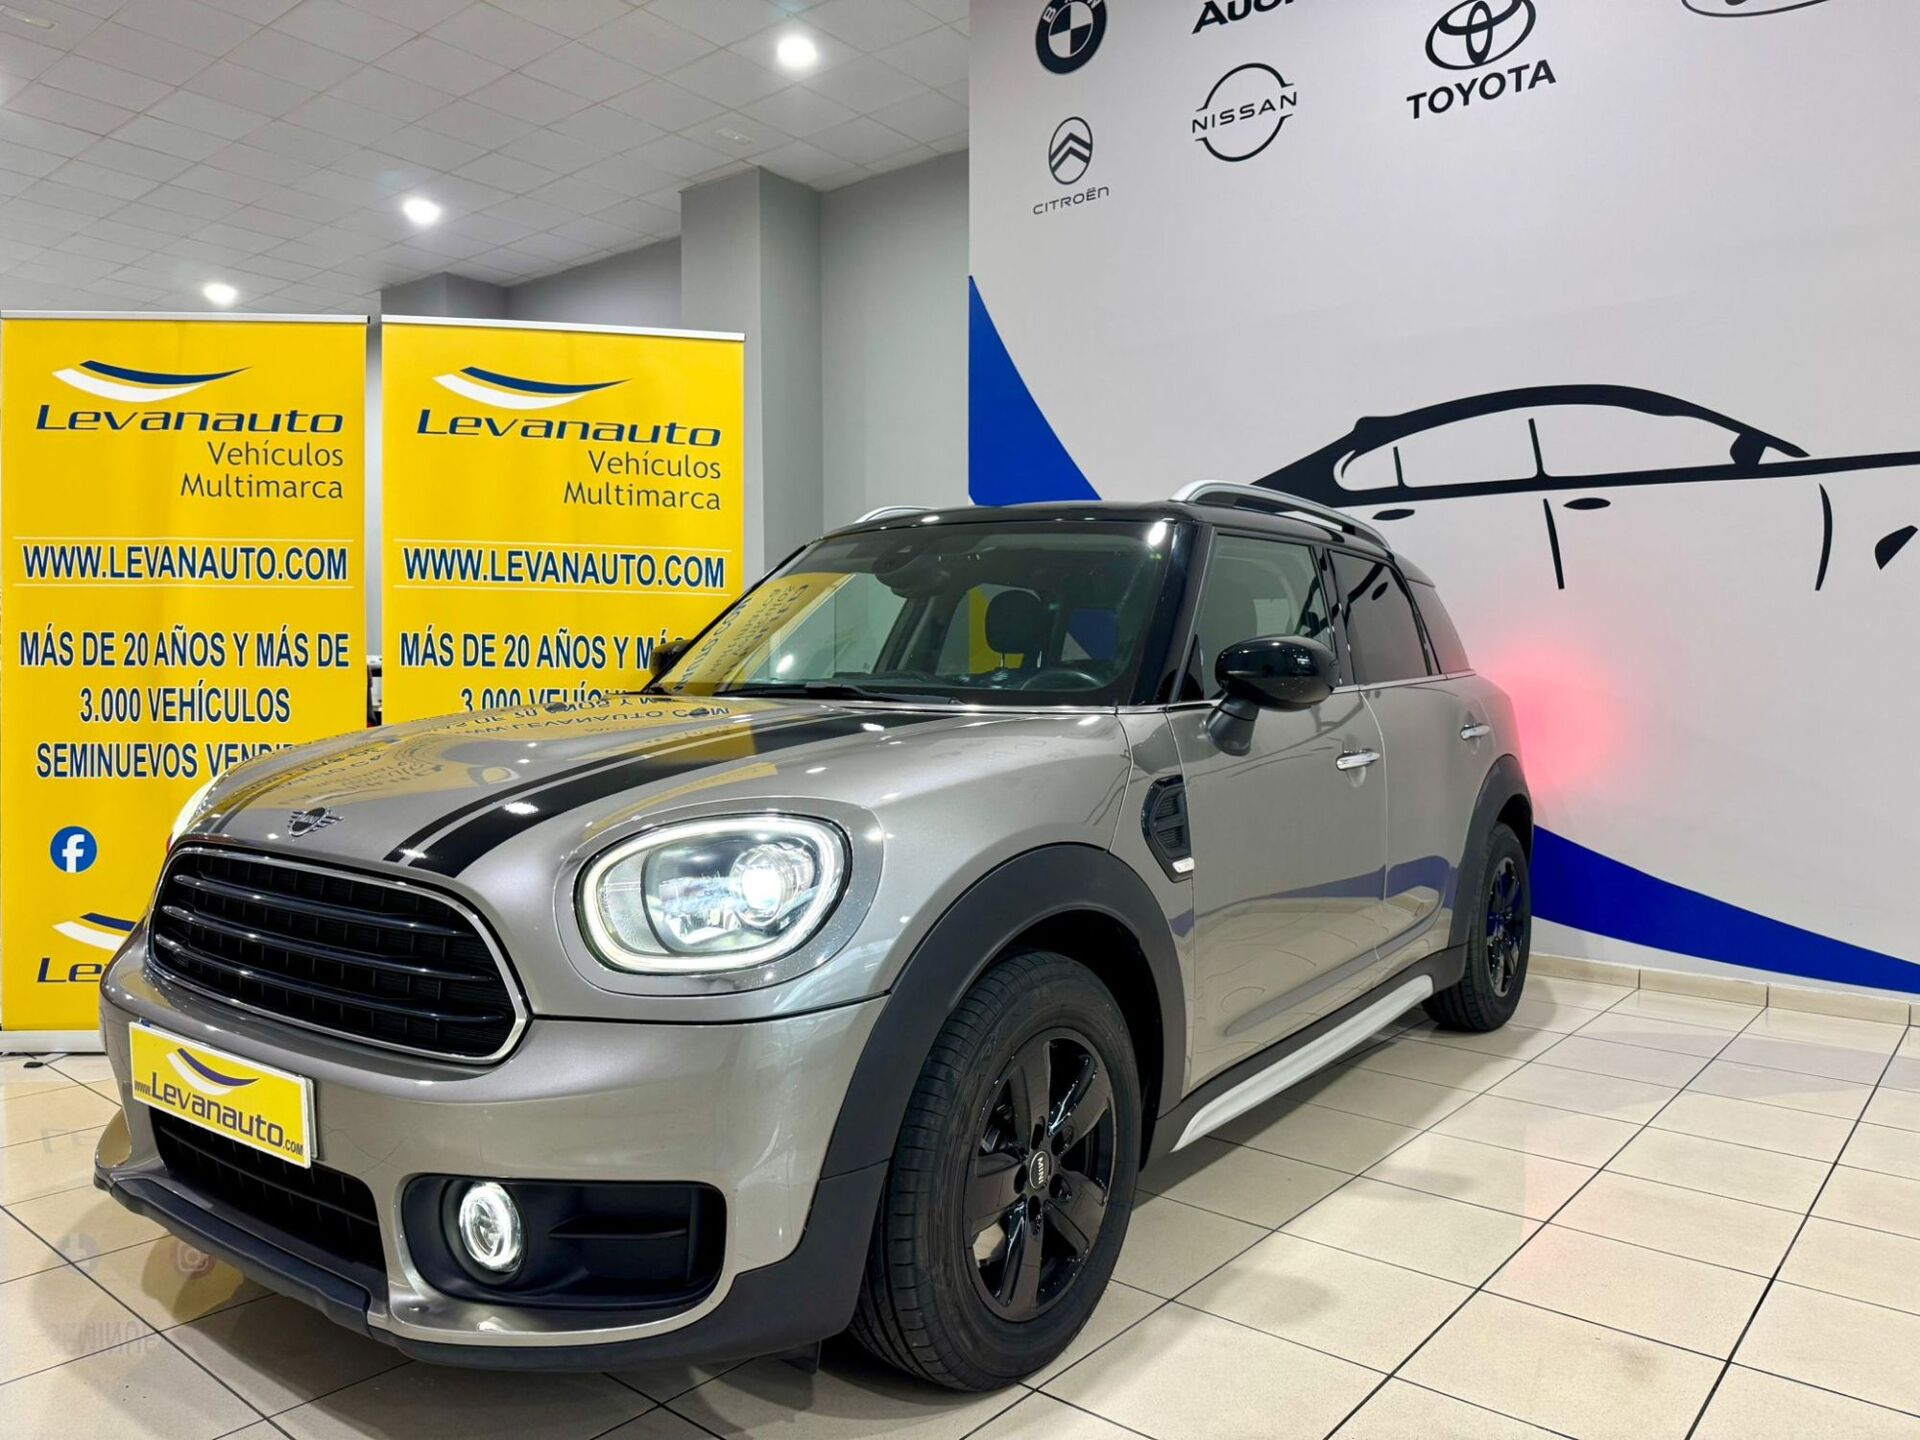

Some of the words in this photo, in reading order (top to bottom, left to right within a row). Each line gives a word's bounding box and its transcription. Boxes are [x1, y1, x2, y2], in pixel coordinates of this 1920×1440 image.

[1406, 59, 1557, 120] TOYOTA
[1191, 91, 1298, 134] NISSAN
[36, 404, 343, 433] Levanauto
[417, 409, 721, 447] Levanauto
[207, 441, 343, 467] Vehículos
[588, 450, 721, 479] Vehículos
[181, 473, 343, 499] Multimarca
[564, 481, 721, 510] Multimarca
[23, 545, 347, 581] WWW.LEVANAUTO.COM
[403, 547, 724, 588] WWW.LEVANAUTO.COM
[20, 624, 74, 667] MÁS
[82, 631, 116, 667] DE
[123, 632, 149, 667] 20
[154, 624, 226, 668] AÑOS
[233, 633, 249, 667] Y
[256, 625, 309, 668] MÁS
[317, 633, 349, 668] DE
[401, 625, 454, 667] MÁS
[463, 633, 496, 667] DE
[503, 634, 530, 668] 20
[536, 628, 606, 669] AÑOS
[613, 636, 629, 669] Y
[80, 687, 141, 722] 3.000
[147, 679, 290, 724] VEHÍCULOS
[36, 742, 198, 778] SEMINUEVOS
